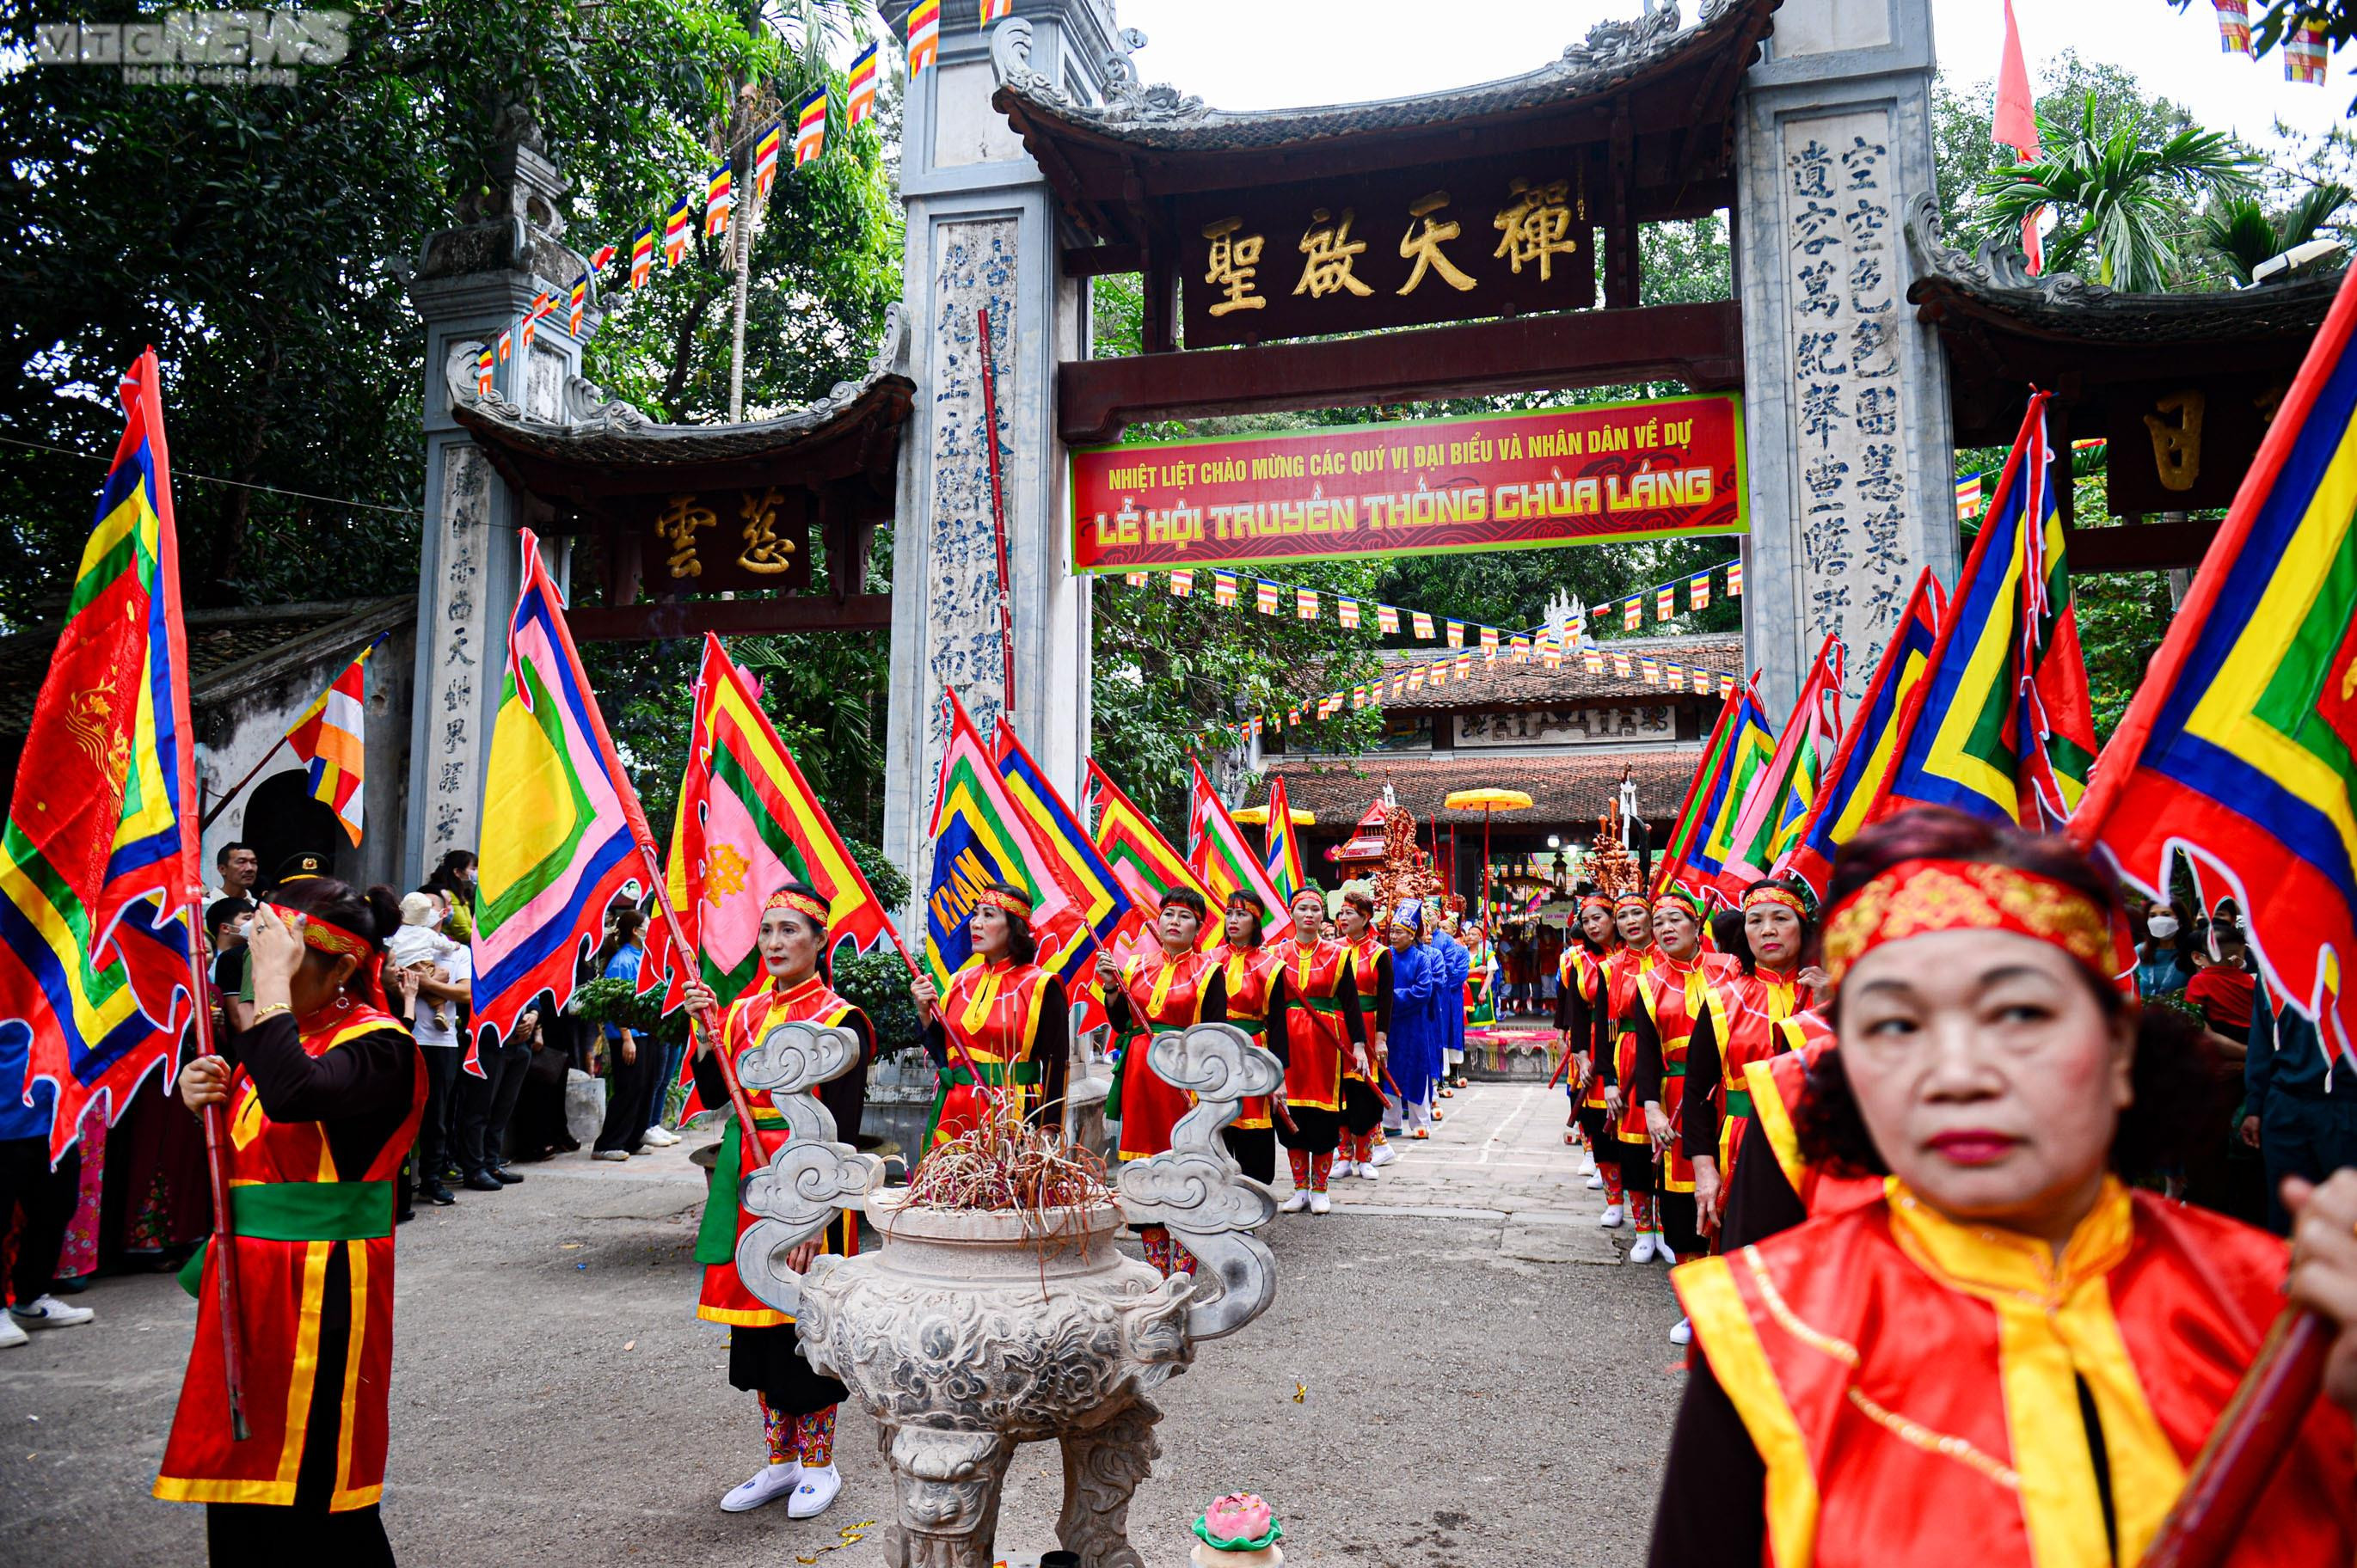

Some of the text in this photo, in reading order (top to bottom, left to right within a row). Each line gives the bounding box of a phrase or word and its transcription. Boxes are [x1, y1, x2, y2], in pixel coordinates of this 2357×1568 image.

[1109, 417, 1693, 493] NHIỆT LIỆT CHÀO MỪNG CÁC QUÝ VỊ ĐẠI BIỂU VÀ NHÂN DÂN VỀ DỰ
[1096, 461, 1711, 549] LỄ HỘI TRUYỀN THỐNG CHÙA LÁNG
